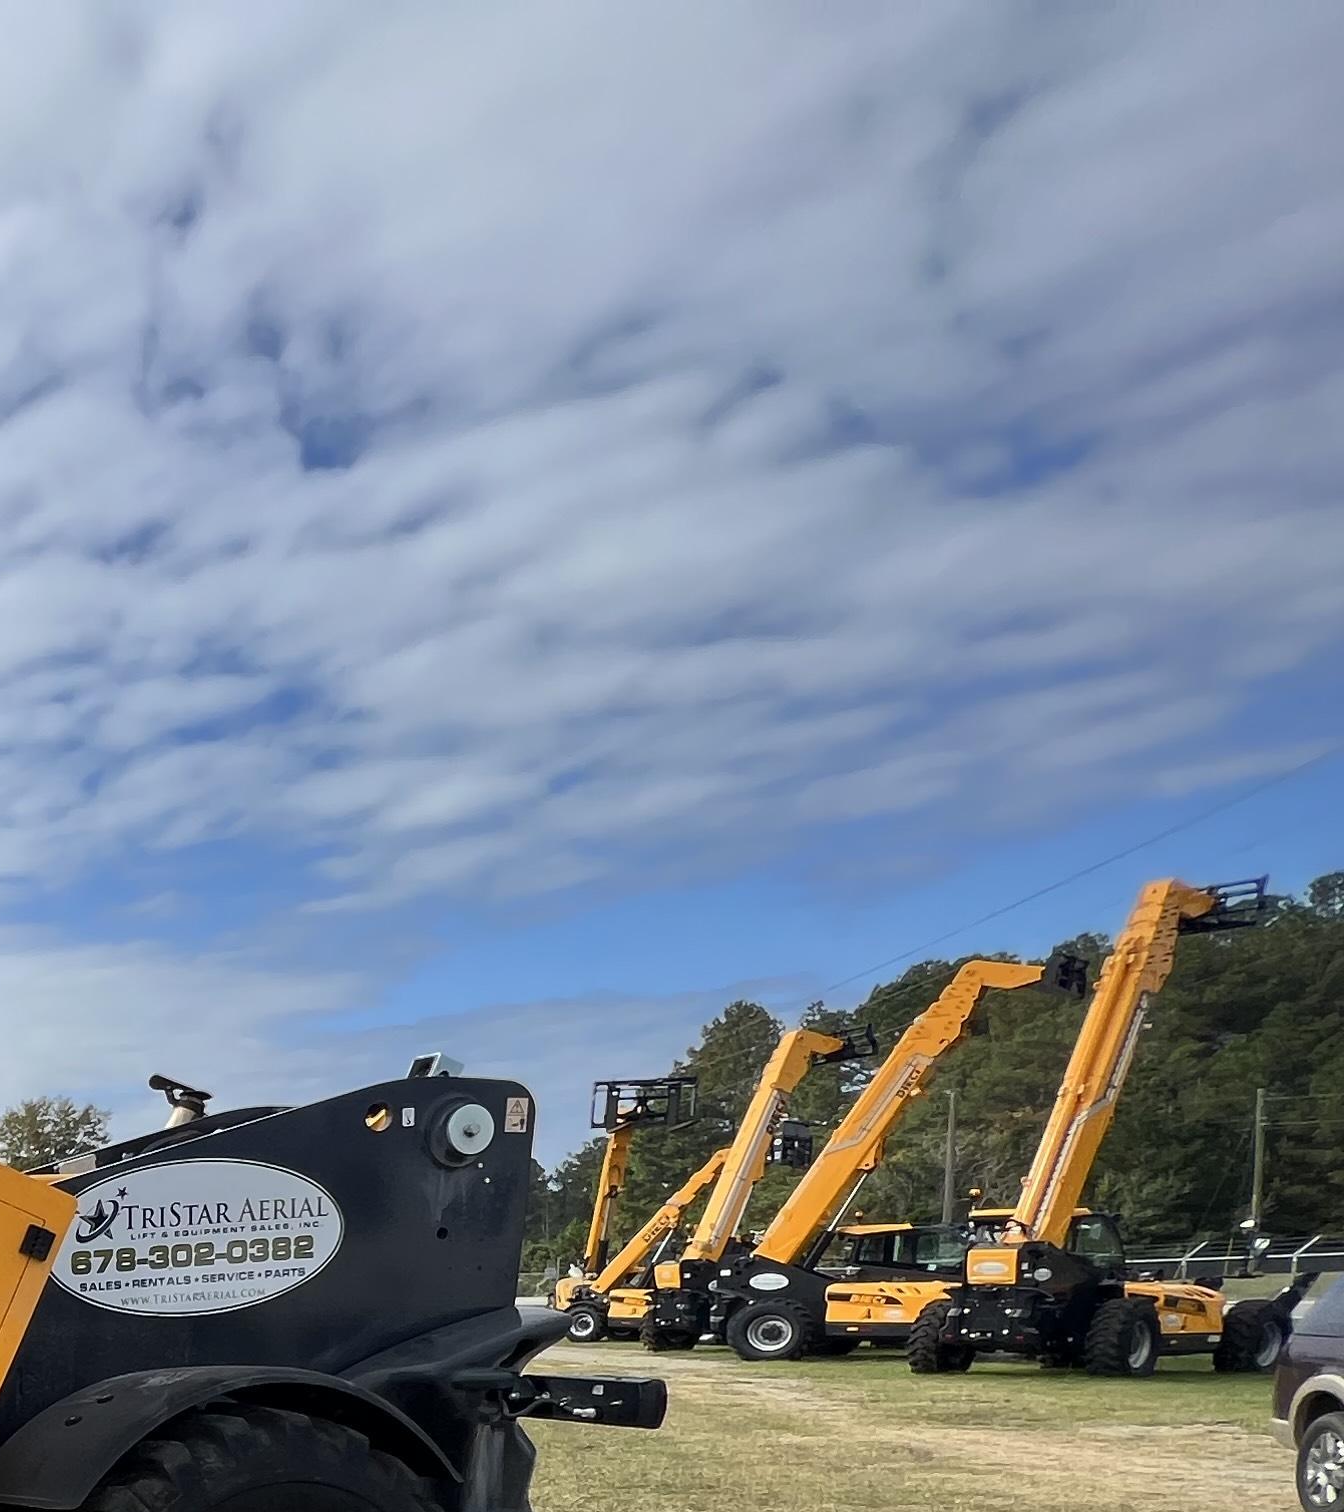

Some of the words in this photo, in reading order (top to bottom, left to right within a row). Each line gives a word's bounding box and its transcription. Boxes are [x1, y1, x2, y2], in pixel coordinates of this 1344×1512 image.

[238, 1196, 329, 1223] AERIAL
[130, 1231, 156, 1241] LIFT
[174, 1225, 246, 1237] EQUIPMENT
[70, 1234, 315, 1276] 678-302-0382
[79, 1280, 122, 1293] SALES
[131, 1275, 192, 1289] RENTALS
[201, 1270, 255, 1284] SERVICE
[264, 1267, 307, 1280] PARTS
